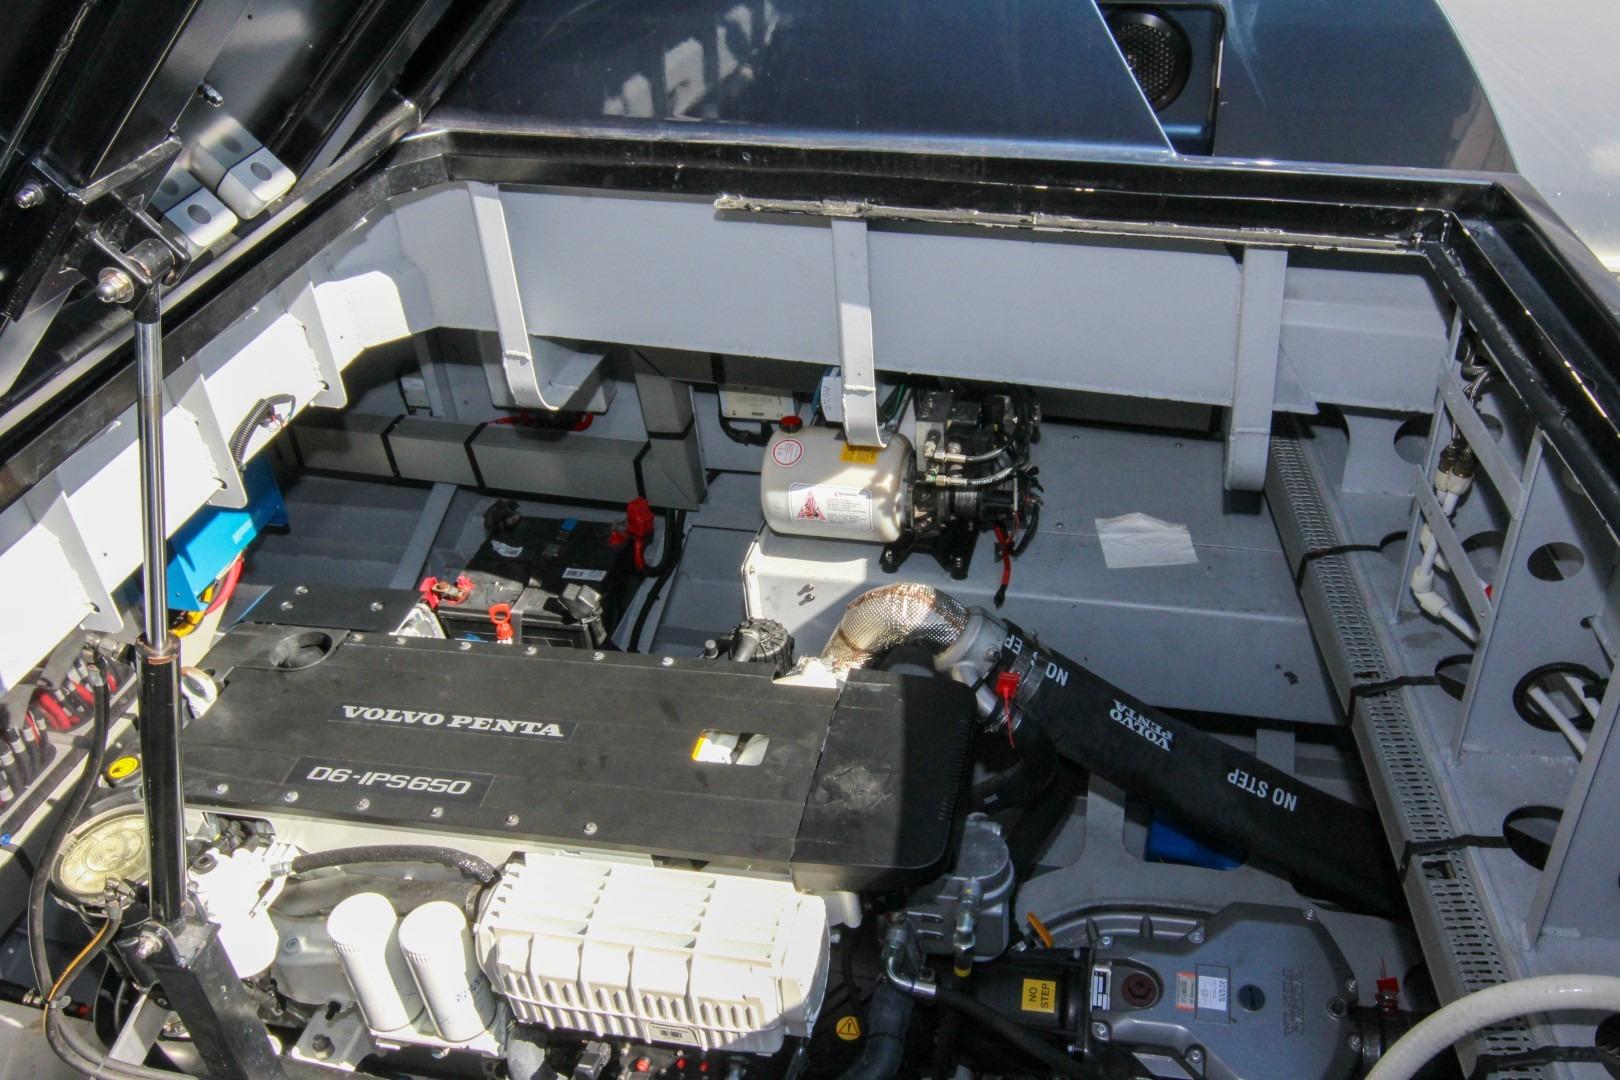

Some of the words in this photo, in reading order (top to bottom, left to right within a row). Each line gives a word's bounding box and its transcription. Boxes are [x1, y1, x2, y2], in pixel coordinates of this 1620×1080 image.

[1045, 661, 1069, 687] NO
[342, 705, 445, 726] VOLVO
[447, 715, 564, 738] PENTA
[1109, 708, 1171, 751] VOLVO
[1113, 698, 1175, 742] PENTA
[306, 766, 472, 795] D6-IPS650
[1227, 768, 1269, 799] STEP
[1272, 787, 1298, 812] NO
[1028, 986, 1038, 1002] NO
[1040, 983, 1050, 1009] STEP
